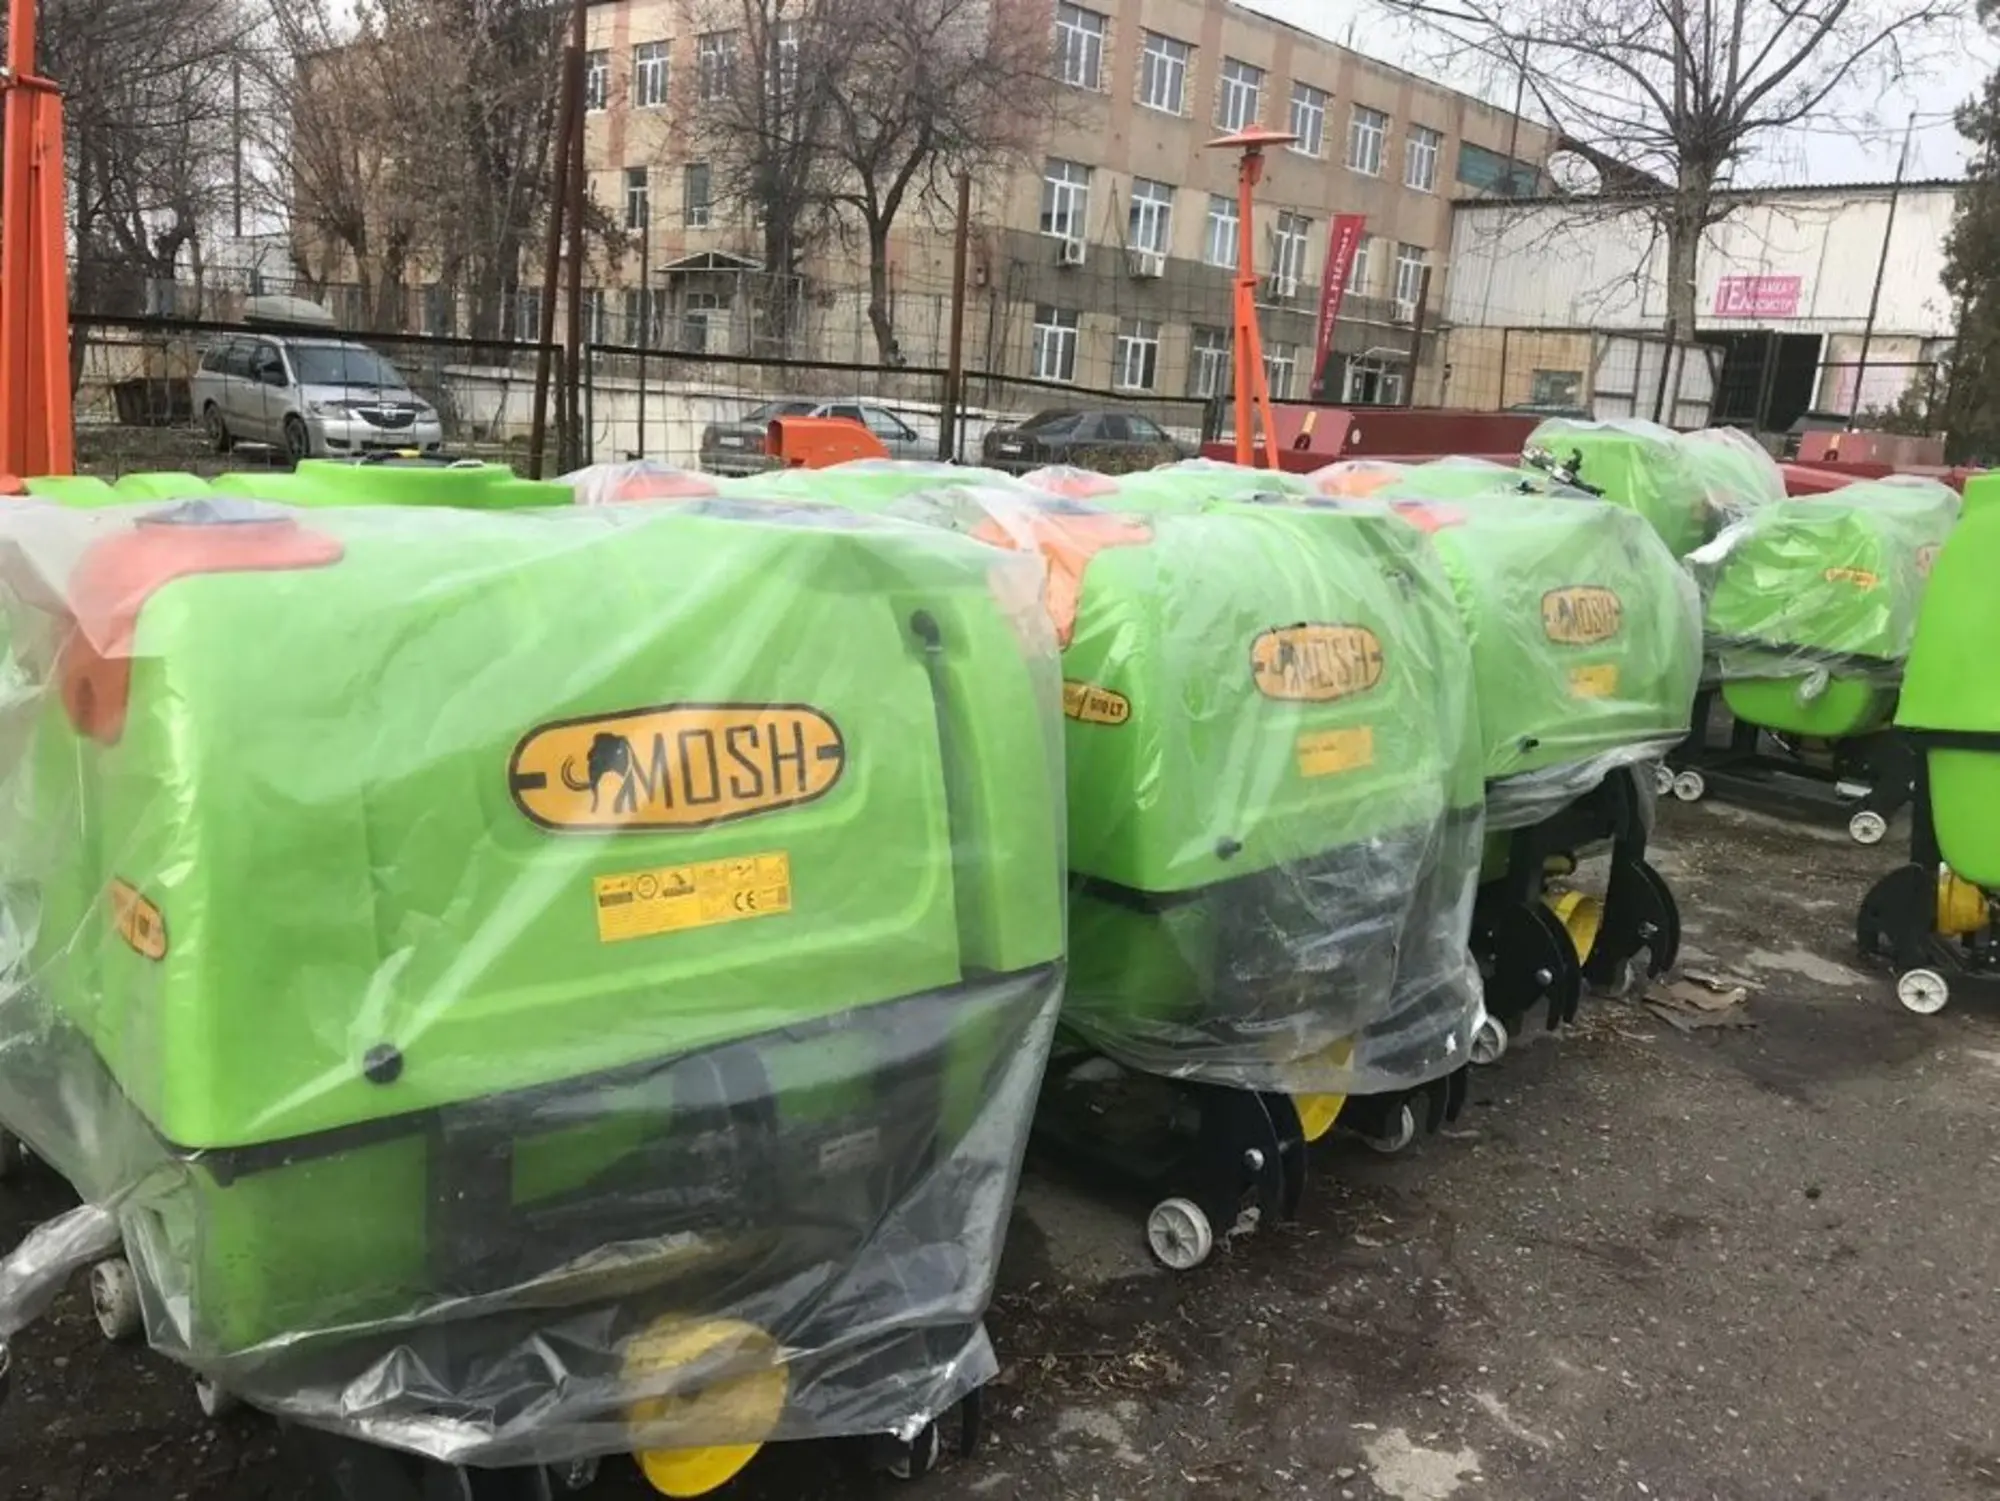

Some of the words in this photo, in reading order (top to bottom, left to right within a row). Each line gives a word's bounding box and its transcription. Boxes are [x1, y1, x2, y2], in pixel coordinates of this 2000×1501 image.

[1565, 597, 1613, 634] MOSH
[1290, 635, 1369, 691] MOSH
[614, 720, 806, 812] MOSH
